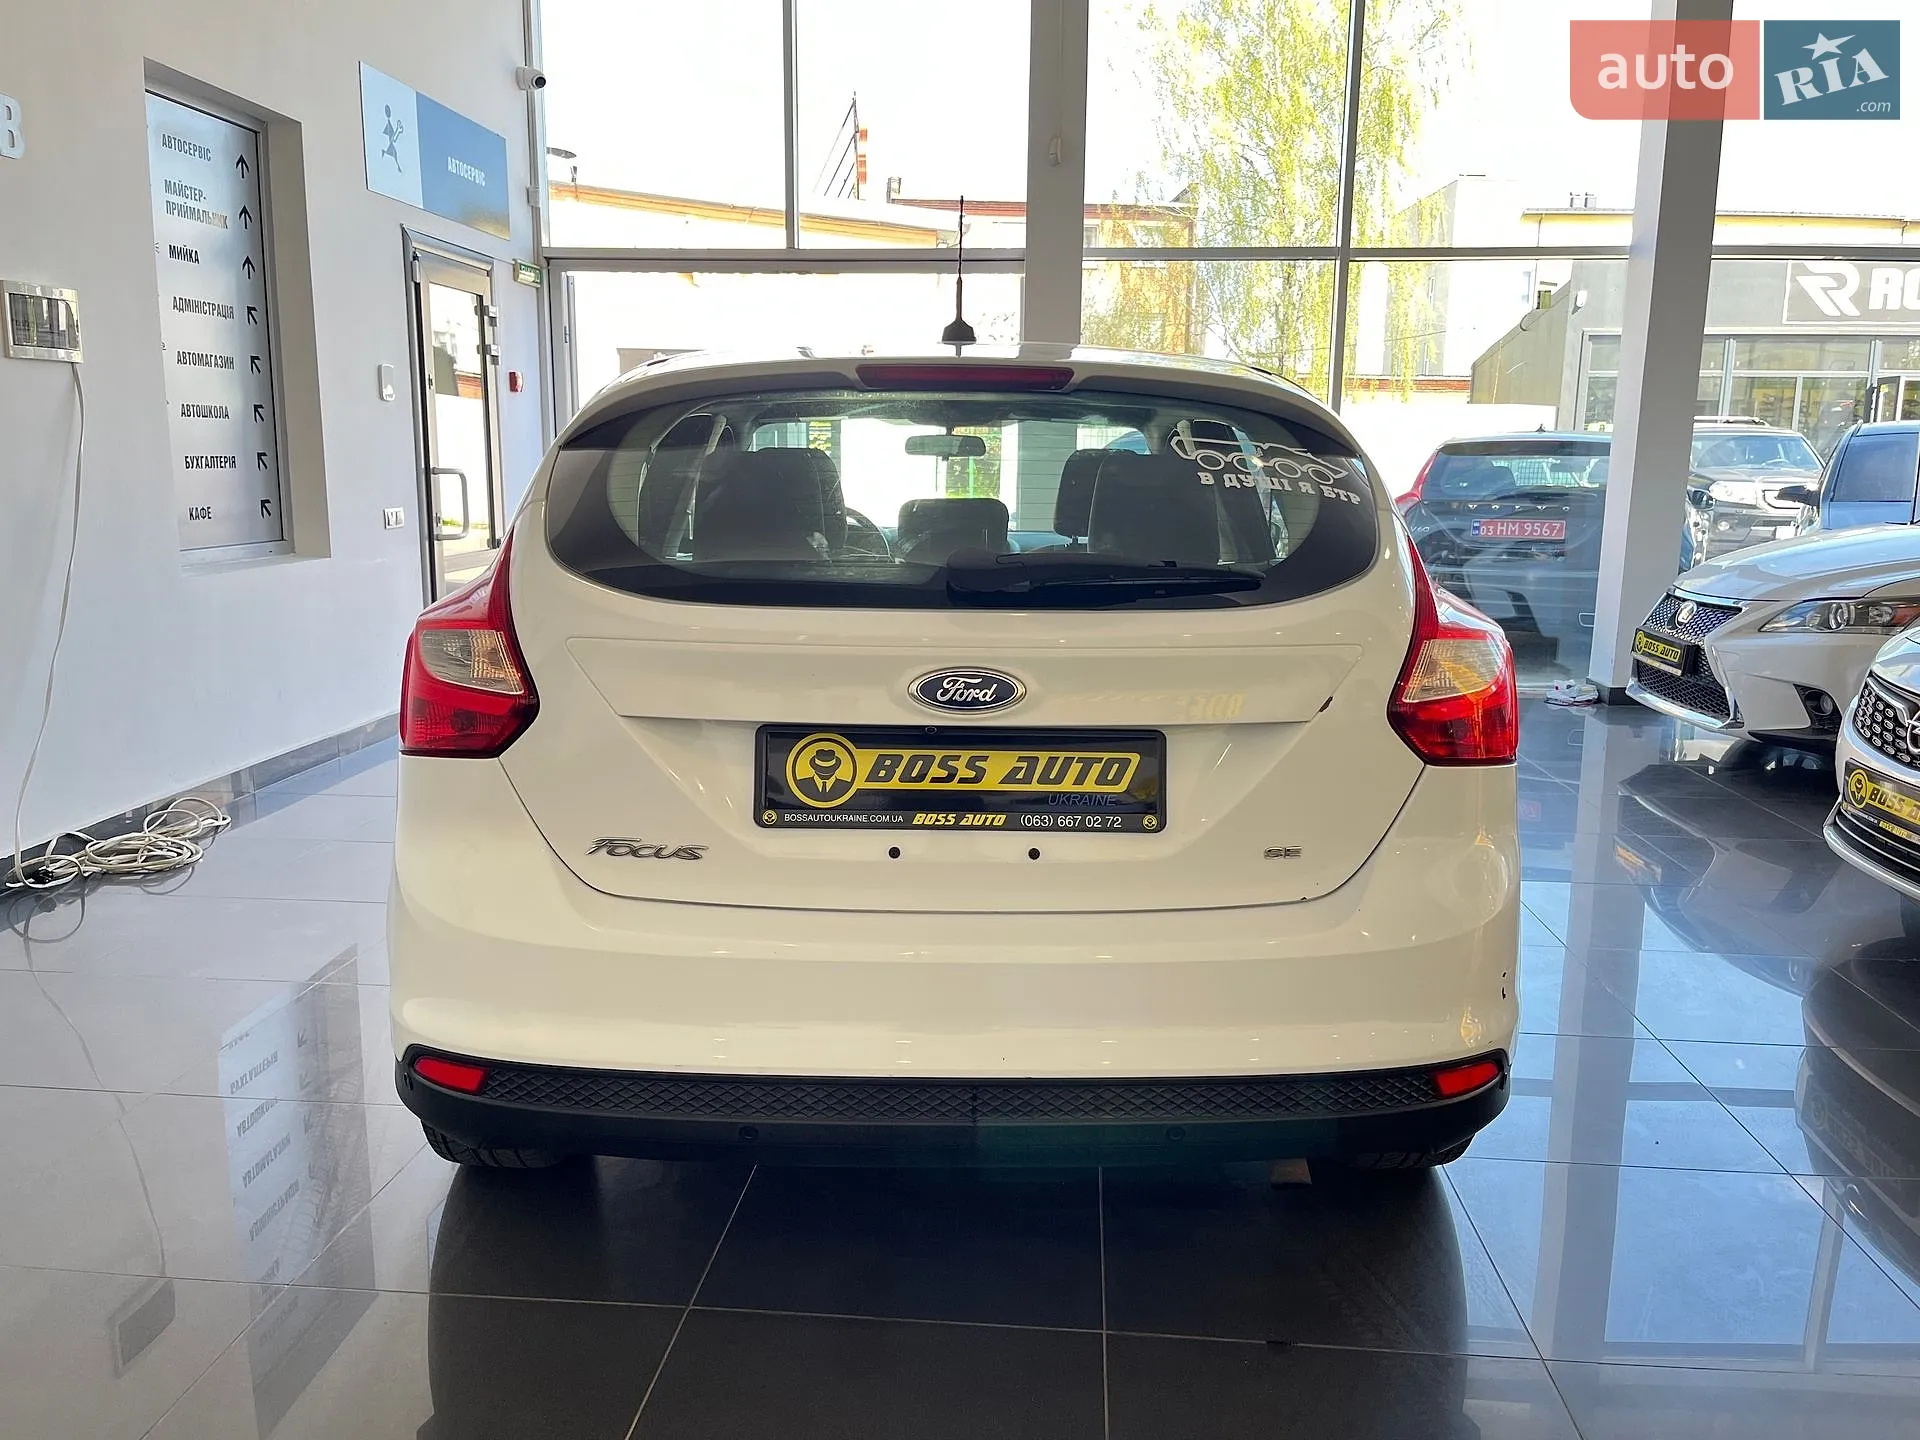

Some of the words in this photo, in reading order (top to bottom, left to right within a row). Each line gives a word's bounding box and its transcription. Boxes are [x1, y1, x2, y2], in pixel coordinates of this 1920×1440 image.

[162, 133, 212, 162] АВТОСЕРВІС
[164, 178, 207, 203] МАЙСТЕР-
[168, 243, 200, 265] МИЙКА
[172, 295, 235, 320] АДМІНІСТРАЦІЯ
[176, 350, 235, 370] АВТОМАГАЗИН
[180, 403, 230, 420] АВТОШКОЛА
[184, 455, 237, 470] БУХГАЛТЕРІЯ
[188, 506, 212, 521] КАФЕ
[1480, 525, 1494, 536] 03
[1524, 523, 1561, 537] 9567
[936, 676, 998, 702] Ford
[864, 753, 989, 784] BOSS
[998, 755, 1132, 787] AUTO
[1048, 793, 1118, 806] UKRAINE
[784, 813, 904, 824] BOSSAUTOUKRAINE.COM.UA
[912, 813, 957, 826] BOSS
[960, 814, 1008, 827] AUTO
[1020, 814, 1054, 828] (063)
[1057, 815, 1082, 827] 667
[1085, 816, 1102, 828] 02
[1105, 816, 1122, 828] 72
